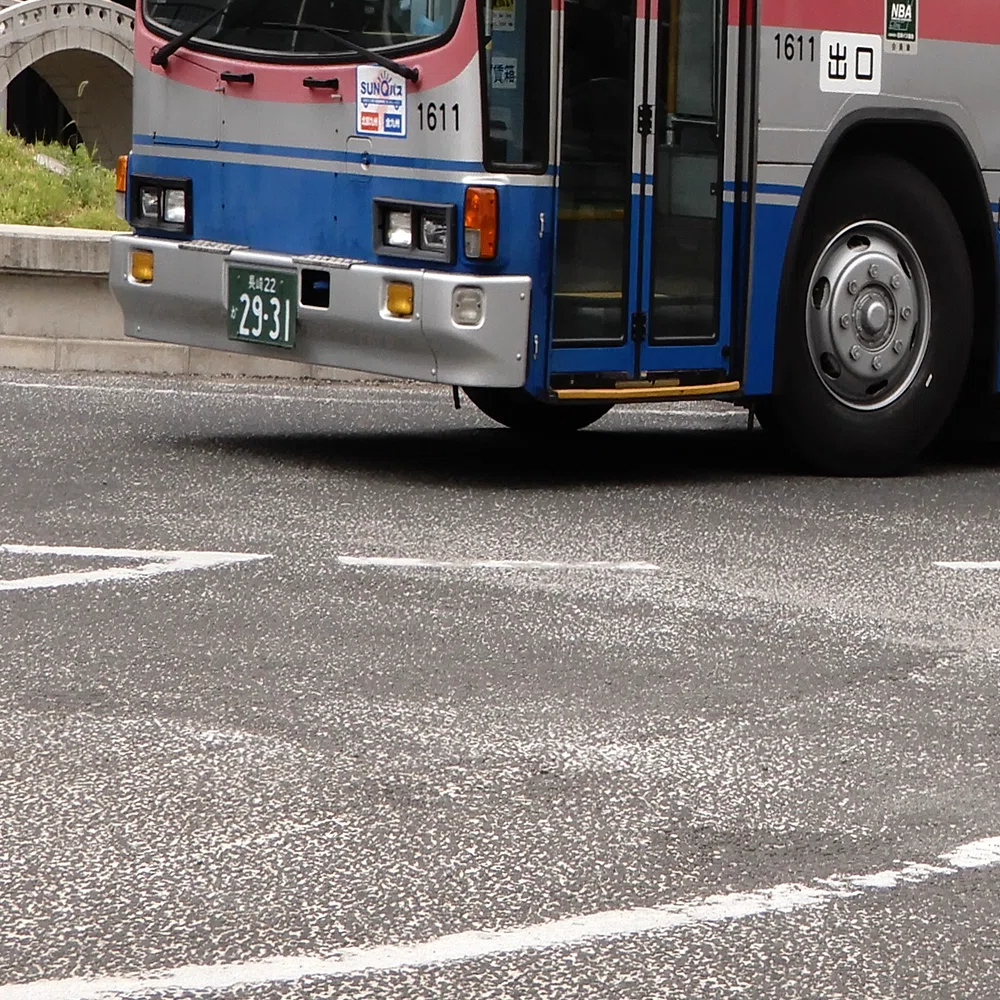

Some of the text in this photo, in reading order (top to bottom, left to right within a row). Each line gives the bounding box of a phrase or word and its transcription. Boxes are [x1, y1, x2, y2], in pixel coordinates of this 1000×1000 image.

[891, 3, 912, 19] NBA
[774, 32, 815, 62] 1611
[828, 42, 874, 81] 出口
[417, 102, 460, 132] 1611
